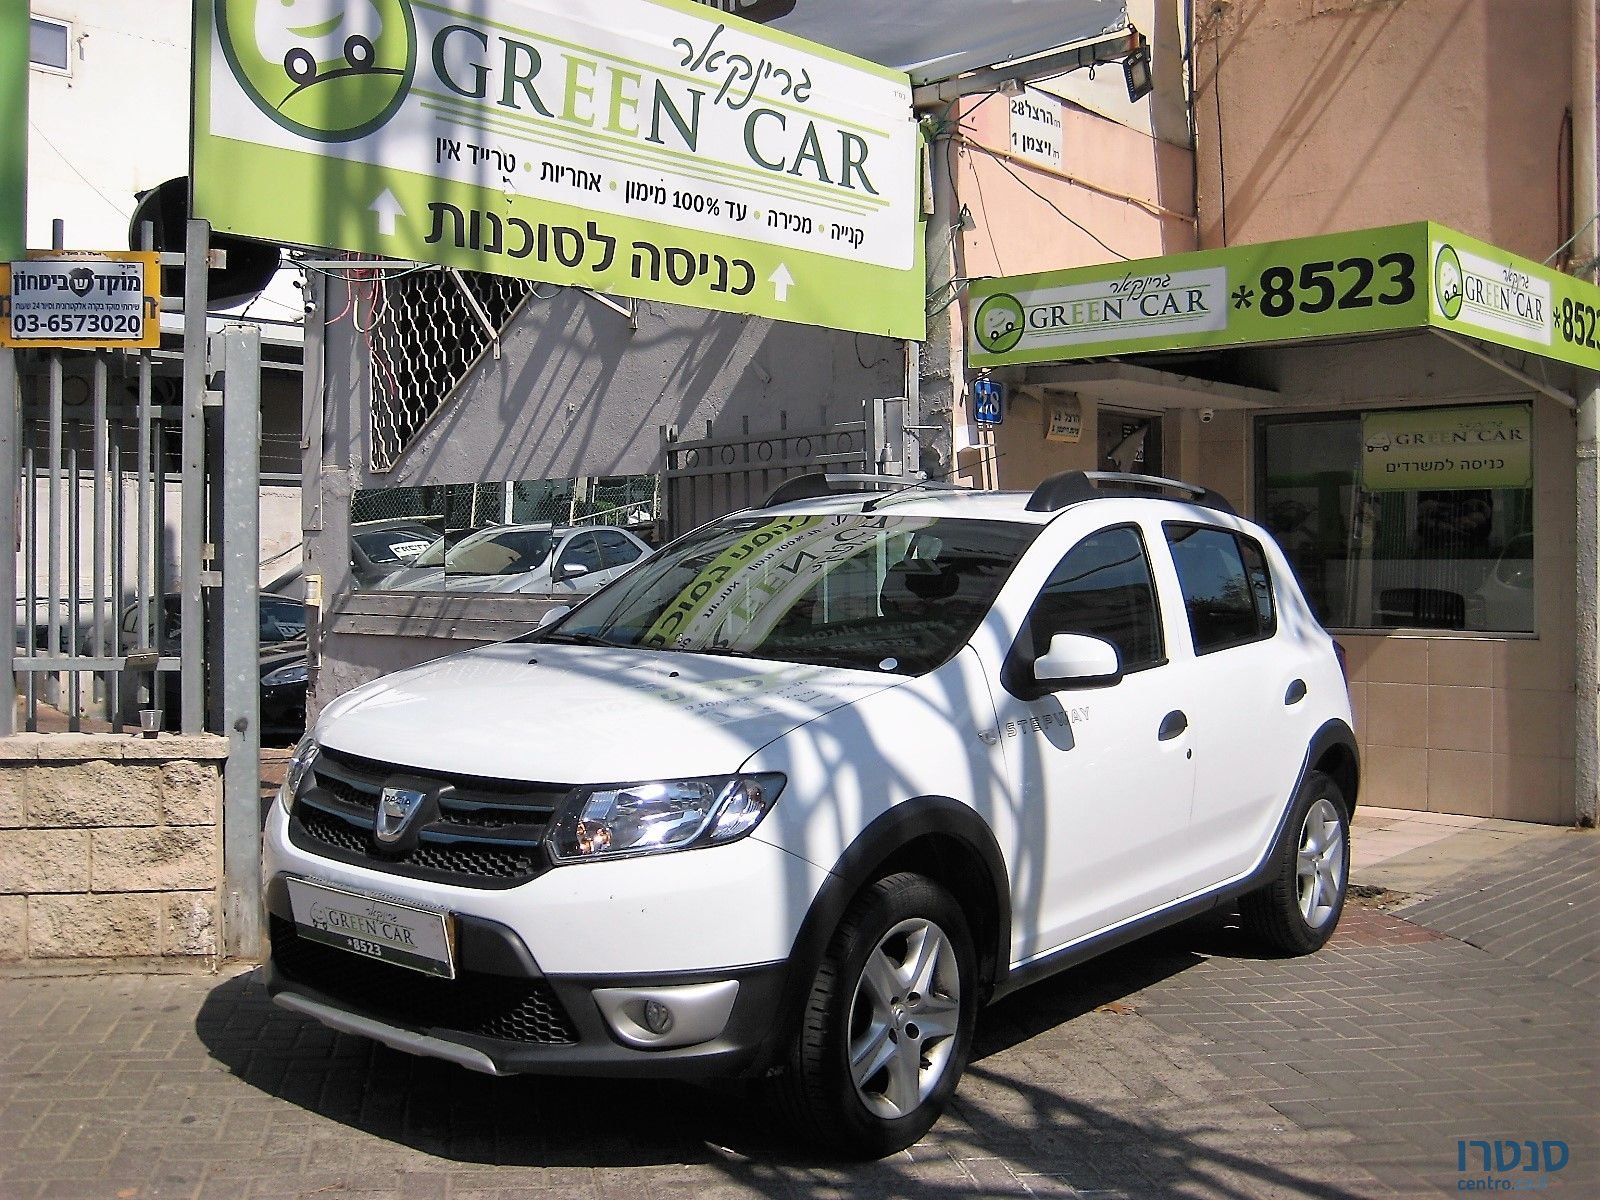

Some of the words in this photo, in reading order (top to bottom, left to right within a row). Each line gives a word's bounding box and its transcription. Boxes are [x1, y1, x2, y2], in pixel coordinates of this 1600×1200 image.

[673, 24, 812, 110] גרינקאר
[431, 24, 705, 152] GREEN
[743, 108, 880, 195] CAR
[436, 137, 461, 163] אין
[1012, 132, 1018, 146] 1
[1022, 135, 1052, 156] ויצמן
[467, 144, 516, 173] טרייד
[540, 162, 602, 193] אחריות
[625, 180, 666, 205] מימון
[672, 192, 720, 216] 100%
[725, 201, 747, 221] עד
[768, 209, 812, 234] מכירה
[424, 202, 617, 273] לסוכנות
[831, 223, 864, 249] קנייה
[632, 240, 756, 297] כניסה
[1109, 271, 1171, 301] גרינקאר
[1029, 298, 1123, 329] GREEN
[1139, 289, 1208, 317] CAR
[1465, 275, 1511, 312] GREEN
[1516, 292, 1544, 323] CAR
[1552, 297, 1600, 350] 852
[14, 314, 141, 332] 03-6573020
[1396, 431, 1468, 445] GREEN
[1477, 428, 1523, 442] CAR
[1386, 458, 1454, 473] למשרדים
[1460, 458, 1505, 471] כניסה
[1006, 706, 1090, 738] STEPWAY
[328, 910, 377, 935] GREEN
[383, 923, 414, 945] CAR
